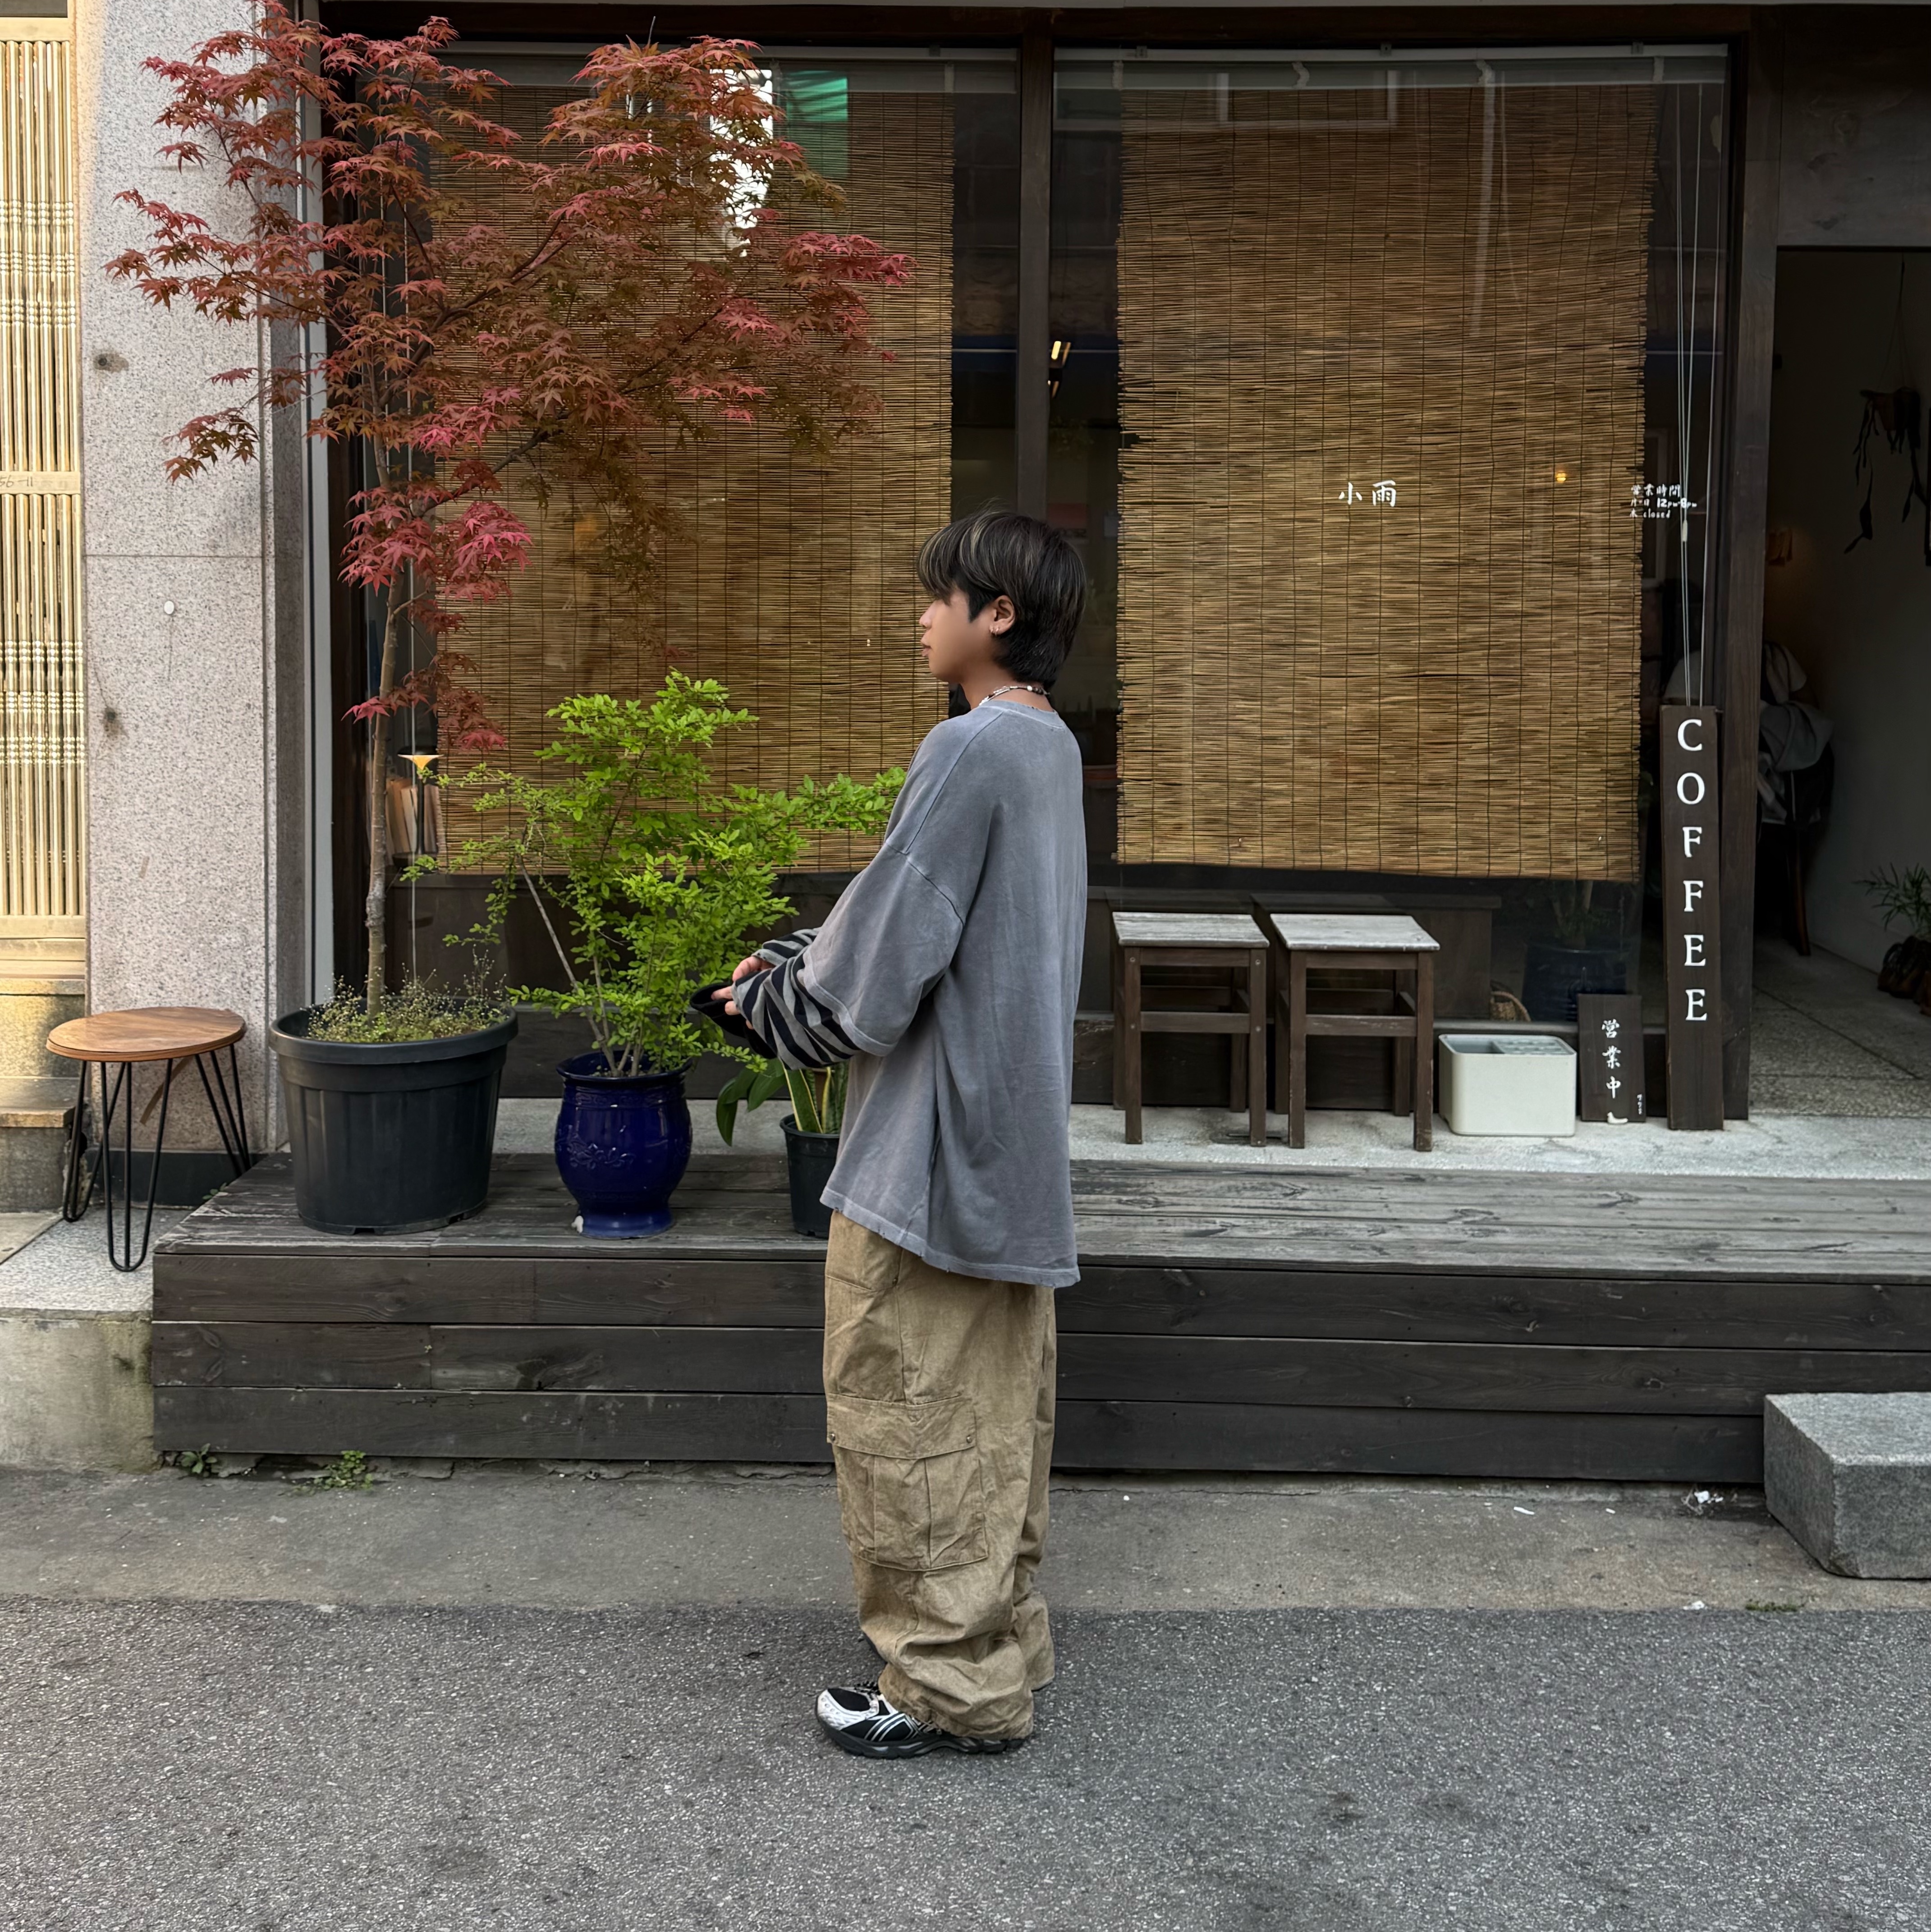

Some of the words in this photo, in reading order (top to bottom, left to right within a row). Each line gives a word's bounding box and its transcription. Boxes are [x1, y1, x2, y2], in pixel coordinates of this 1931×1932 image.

[1338, 480, 1397, 507] 小雨
[1643, 508, 1670, 518] closed
[1677, 719, 1707, 1021] COFFEE
